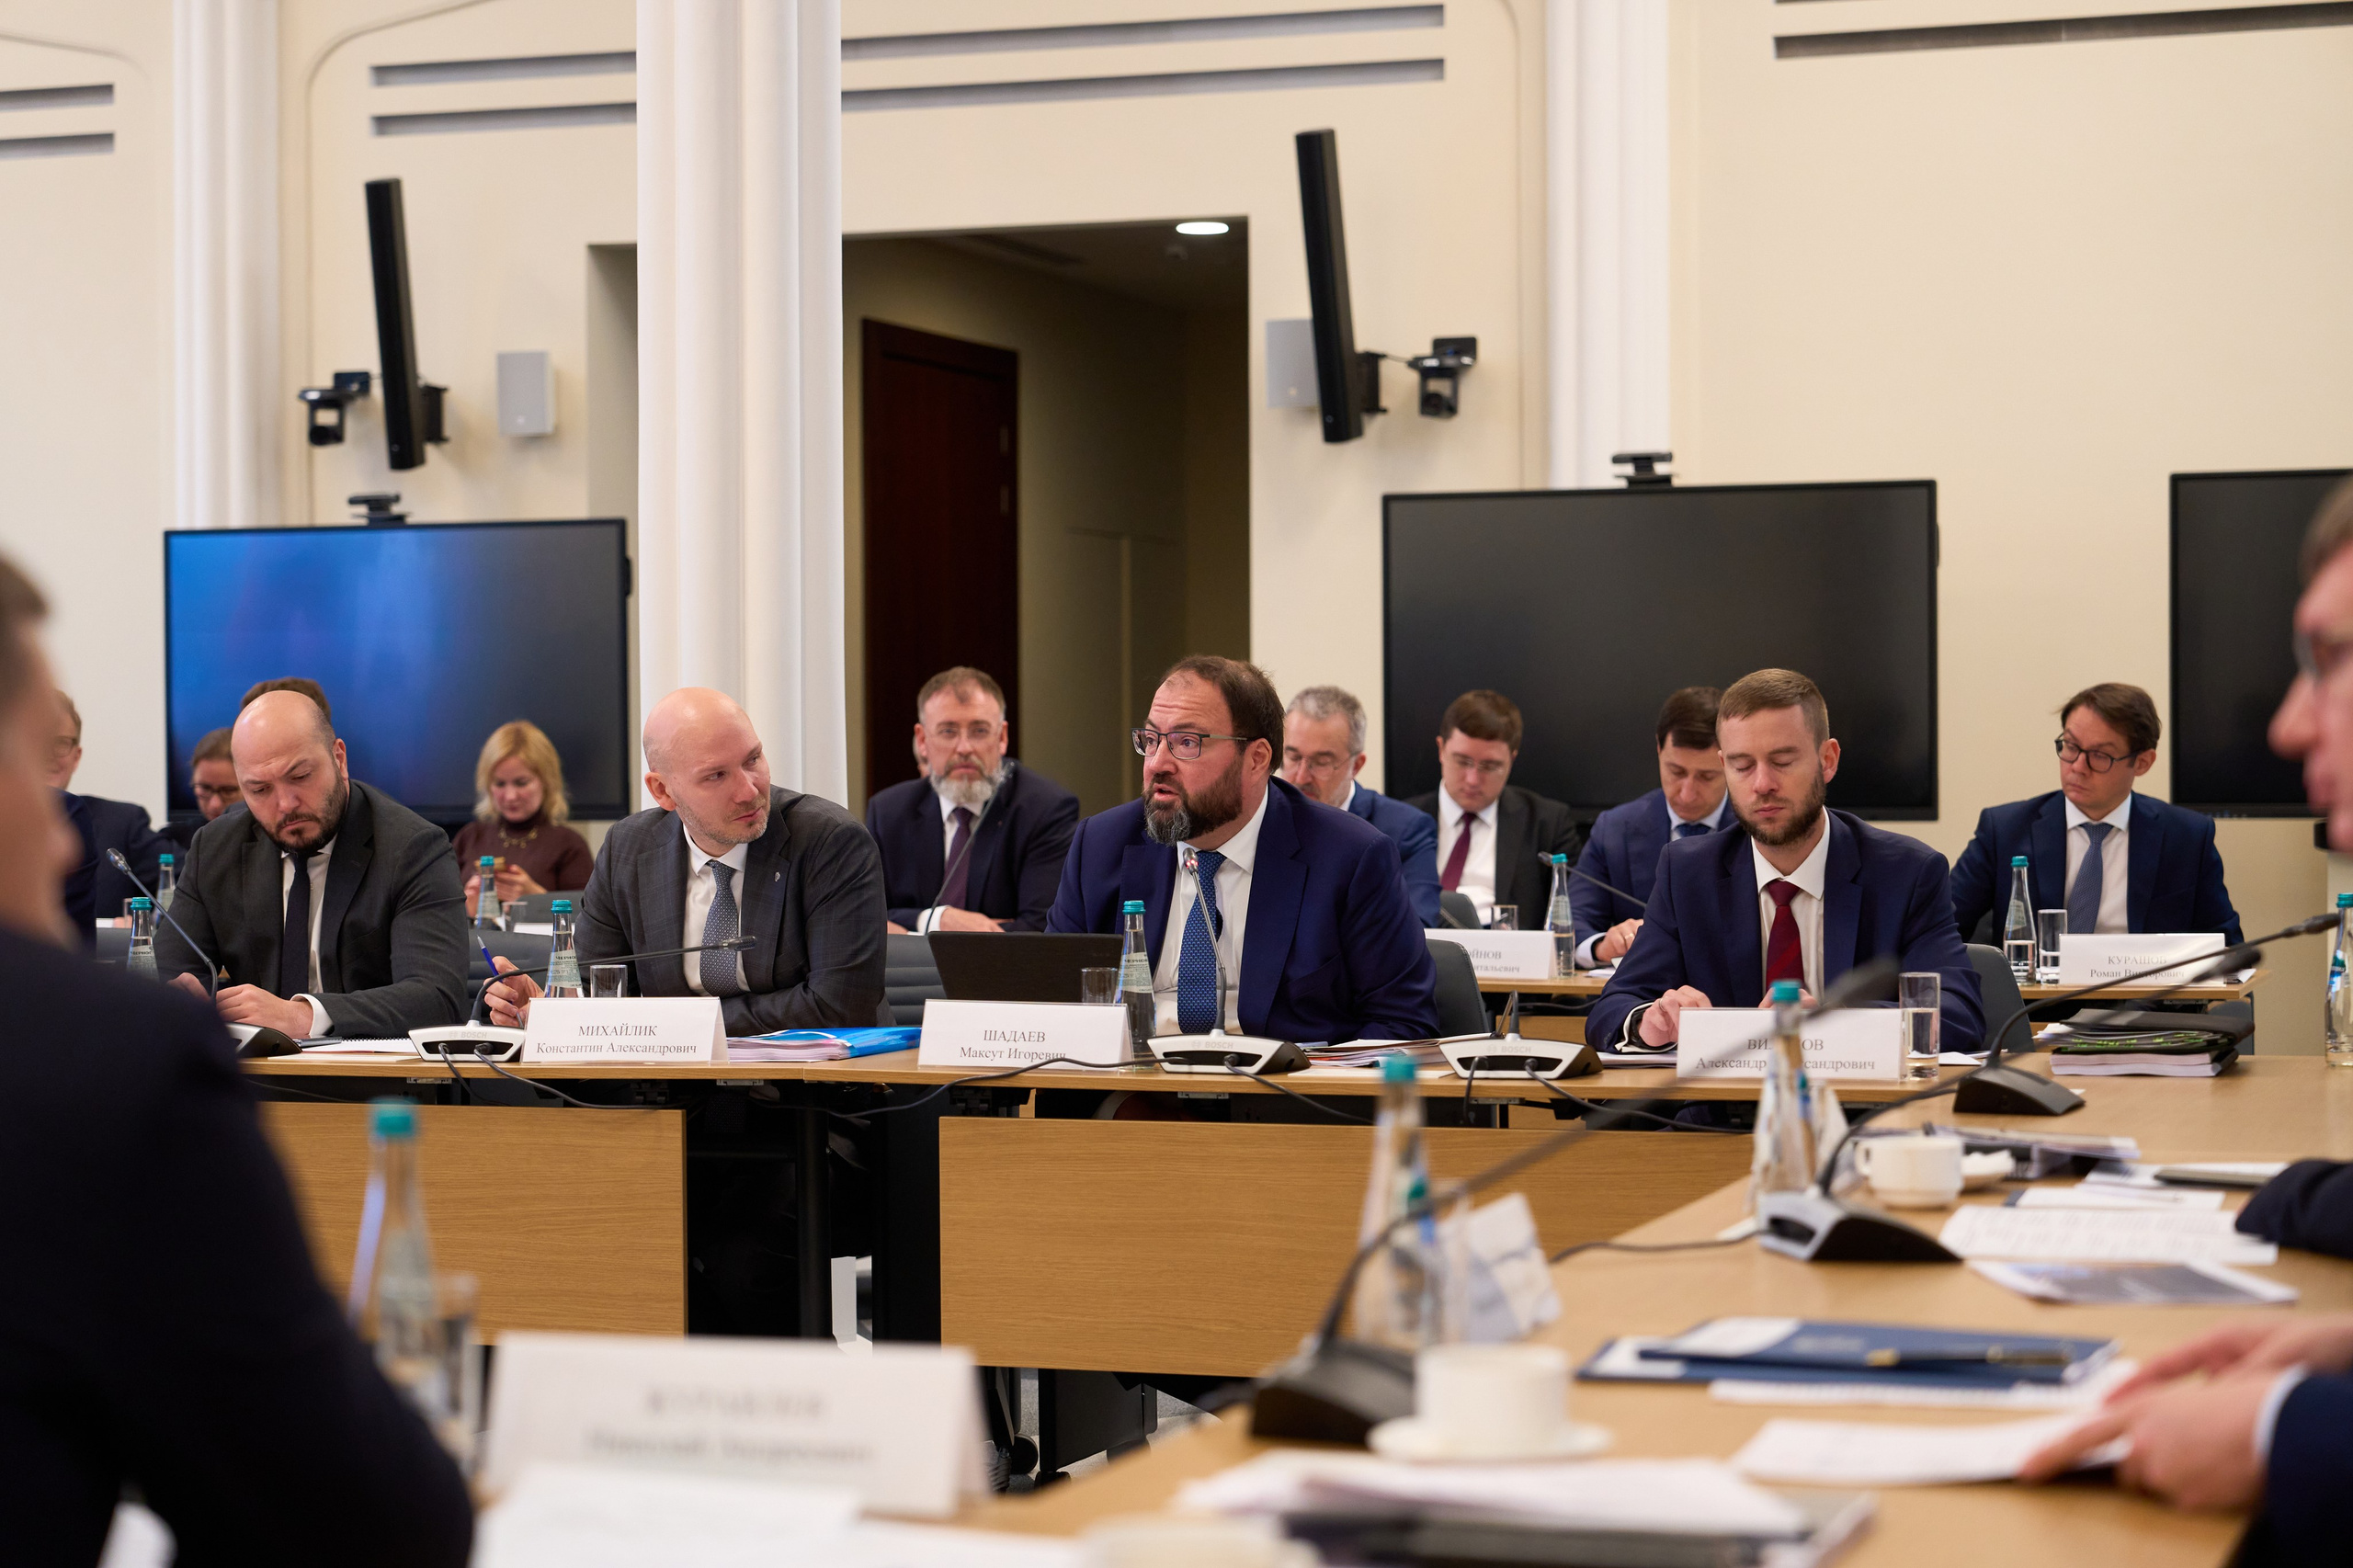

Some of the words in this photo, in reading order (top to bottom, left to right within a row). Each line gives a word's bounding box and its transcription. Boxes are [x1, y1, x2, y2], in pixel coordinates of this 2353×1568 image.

[2108, 955, 2167, 965] КУРАШОВ
[1473, 964, 1520, 973] итальевич
[2090, 969, 2121, 978] Роман
[578, 1022, 658, 1036] МИХАЙЛИК
[983, 1029, 1046, 1043] ШАДАЕВ
[537, 1041, 603, 1054] Константин
[606, 1041, 697, 1056] Александрович
[1747, 1038, 1824, 1051] ВИОВ
[960, 1046, 1005, 1062] Максут
[1007, 1048, 1066, 1062] Игоревич
[1696, 1057, 1767, 1071] Александр
[1802, 1060, 1876, 1071] сандрович
